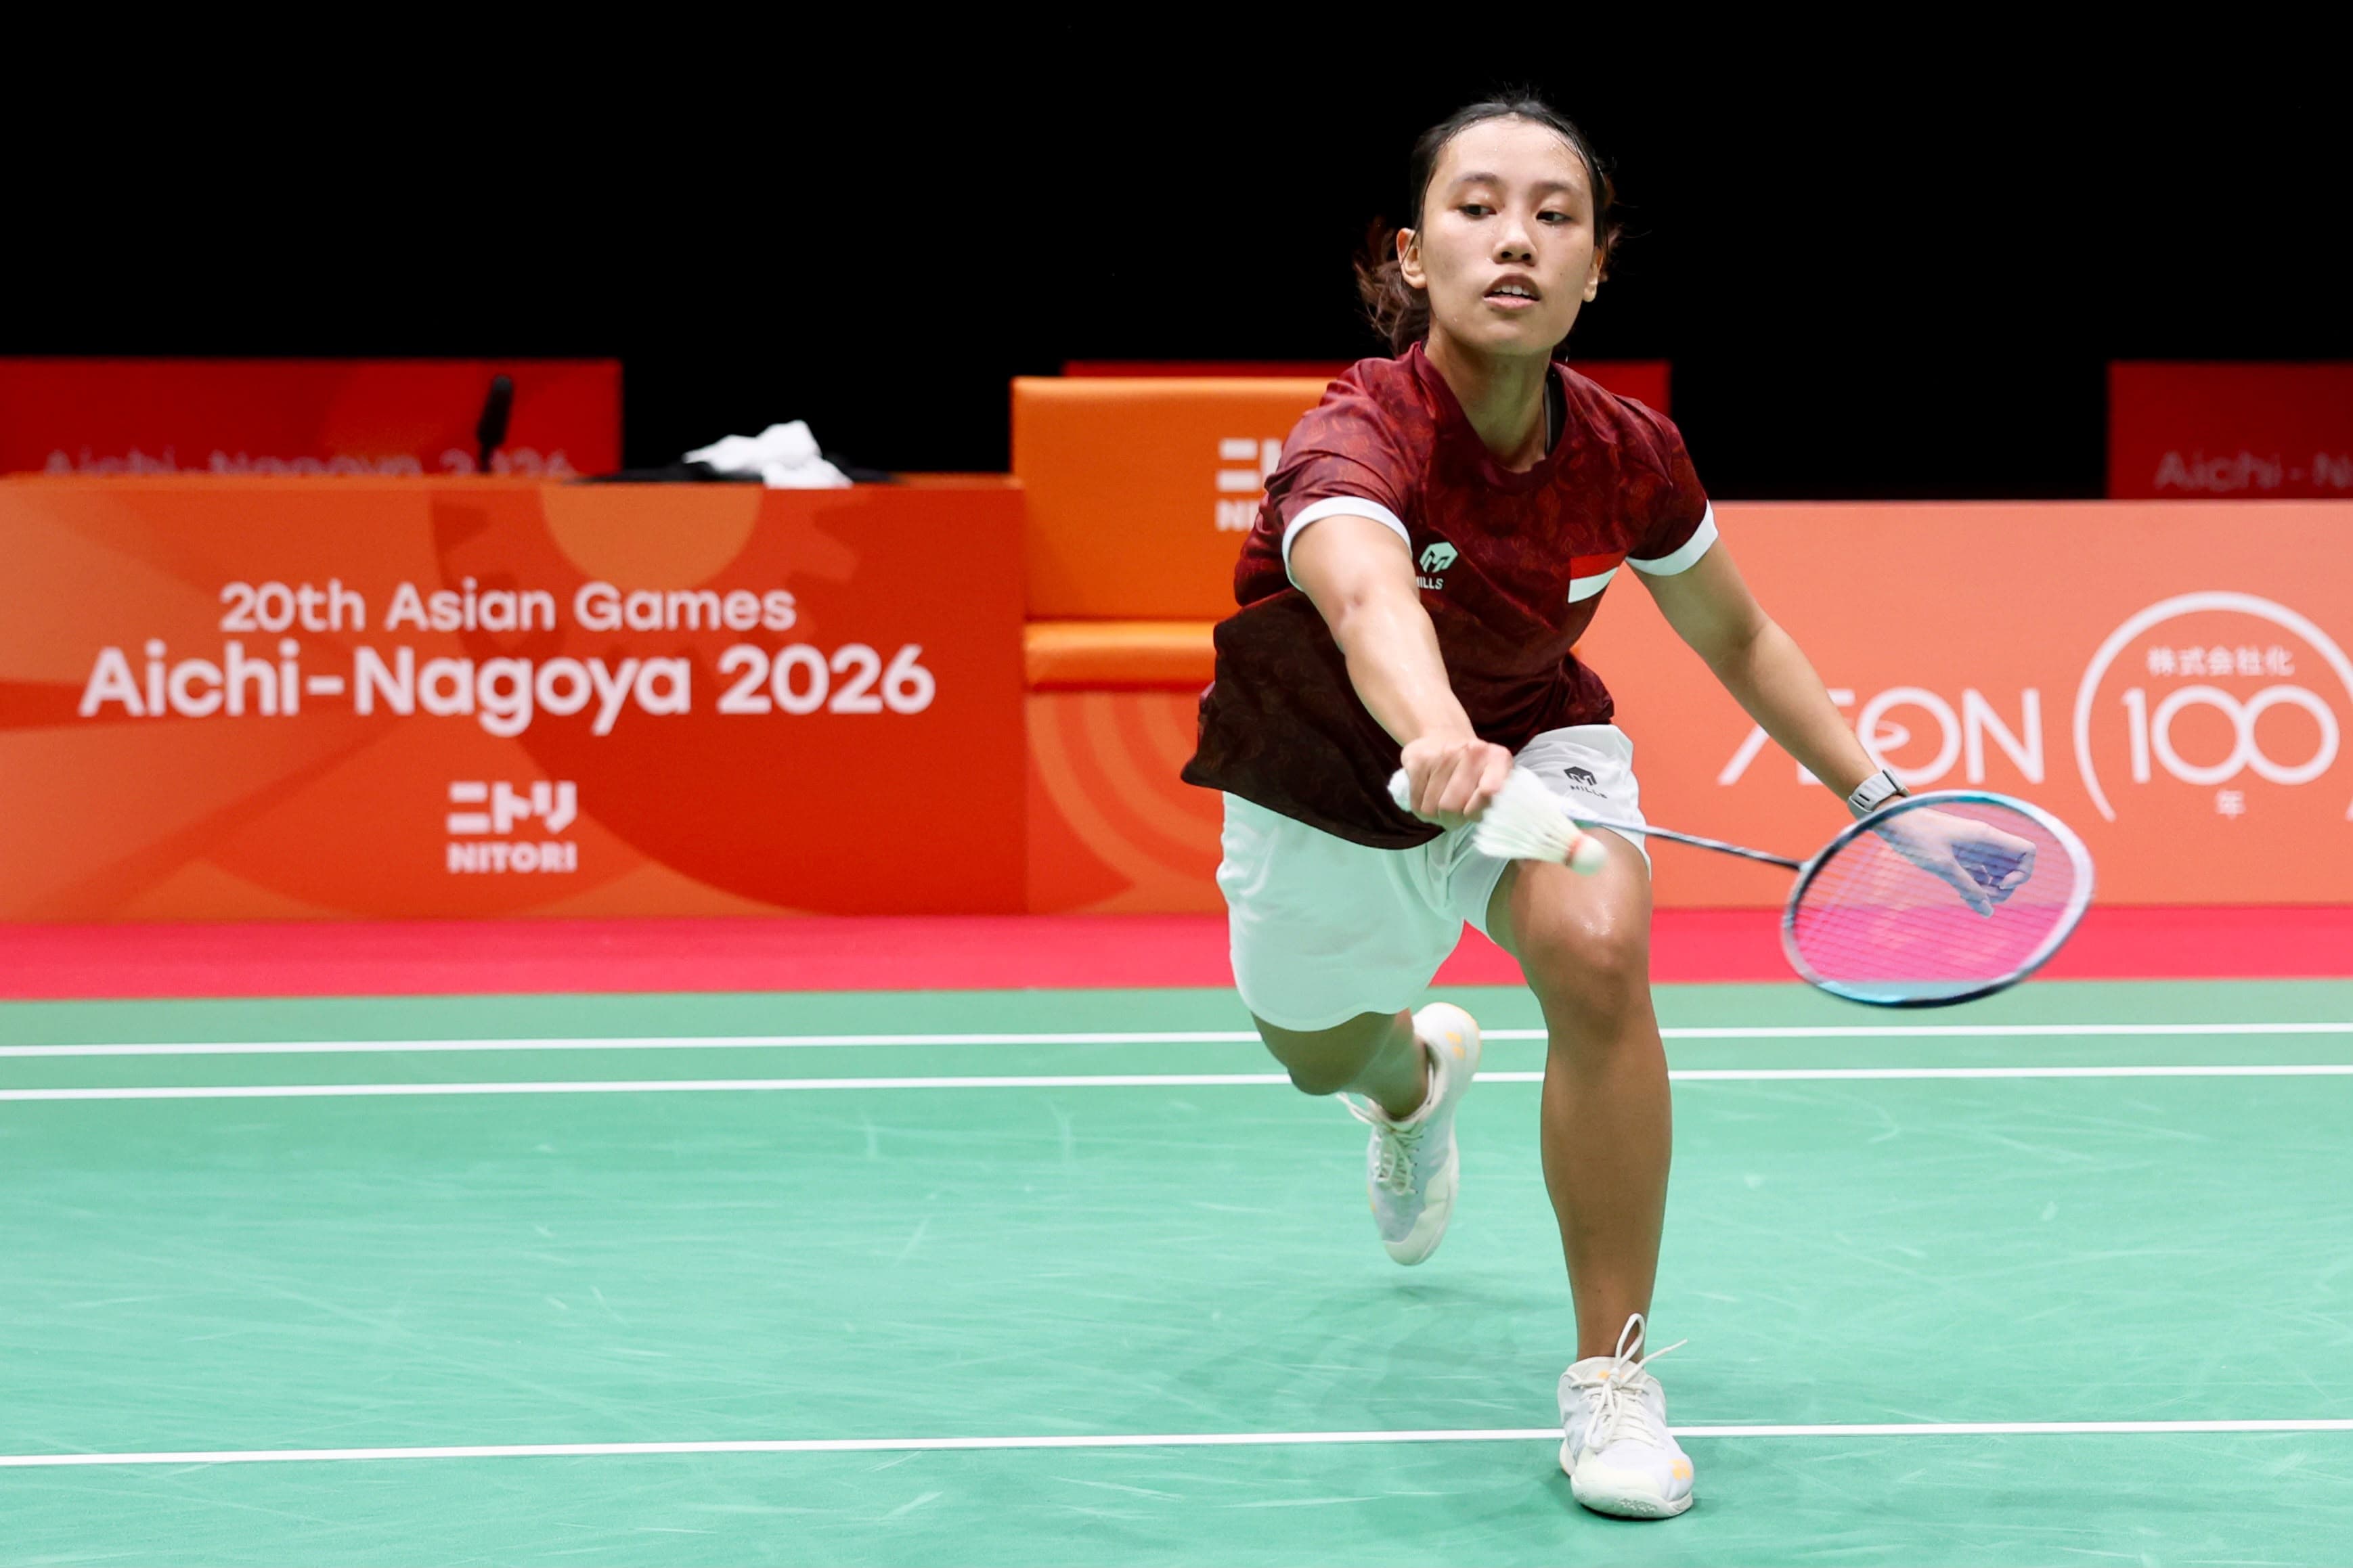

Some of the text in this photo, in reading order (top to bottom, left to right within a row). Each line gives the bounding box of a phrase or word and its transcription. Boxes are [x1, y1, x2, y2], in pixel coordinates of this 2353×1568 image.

[220, 577, 797, 633] 20th Asian Games
[79, 639, 936, 737] Aichi-Nagoya 2026
[2121, 684, 2340, 786] 100
[446, 781, 577, 834] ニトリ
[2215, 790, 2246, 819] 年
[447, 841, 577, 874] NITORI
